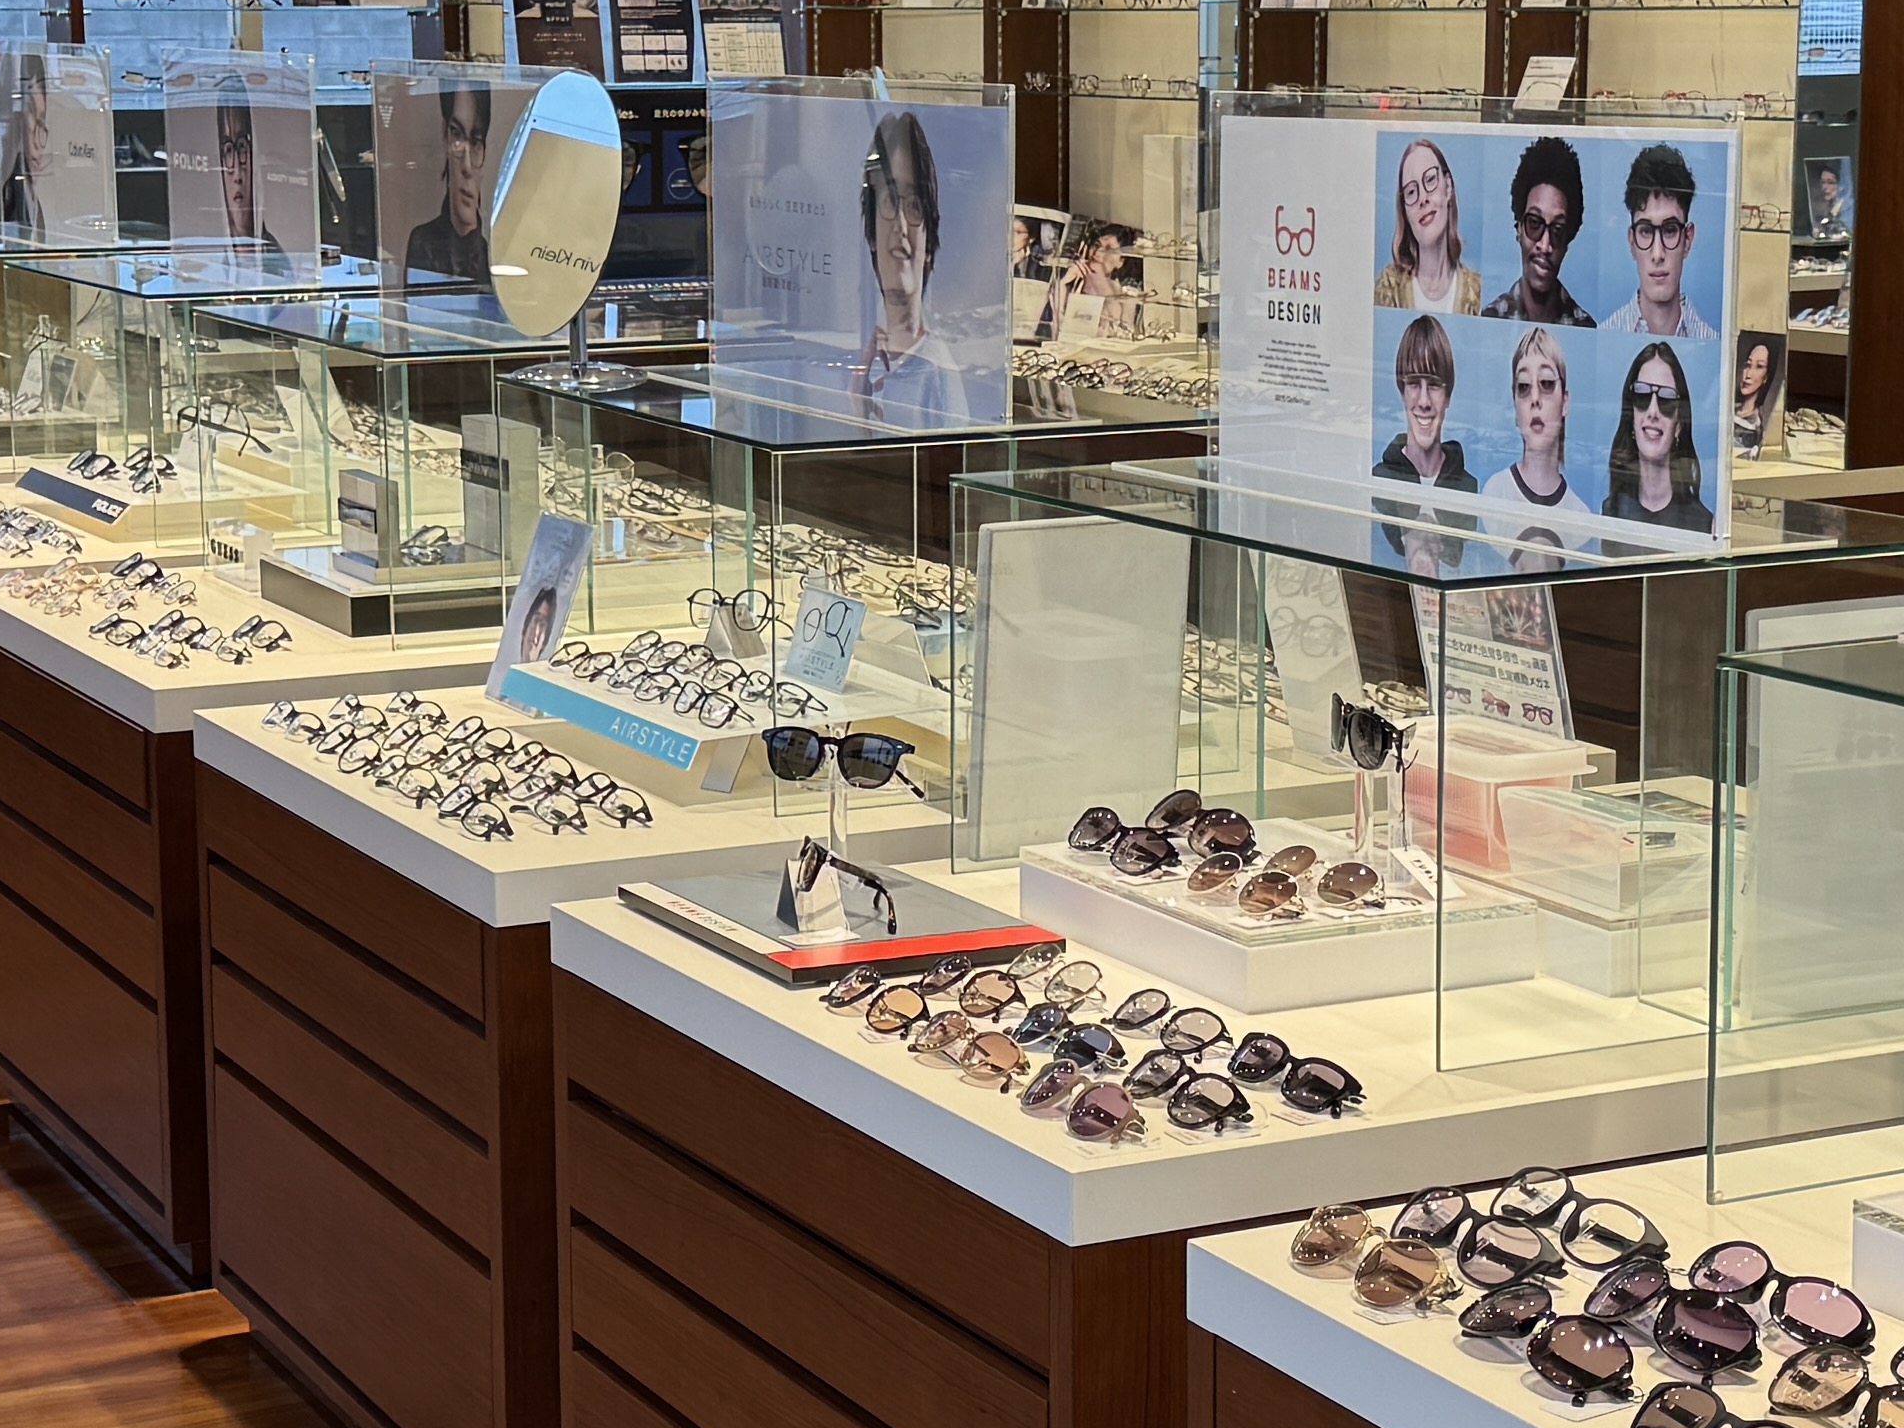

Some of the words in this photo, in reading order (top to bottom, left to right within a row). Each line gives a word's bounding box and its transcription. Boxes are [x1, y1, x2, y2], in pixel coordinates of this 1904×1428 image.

[172, 152, 209, 172] POLICE
[1267, 267, 1322, 293] BEAMS
[1267, 300, 1322, 325] DESIGN
[609, 715, 693, 764] AIRSTYLE
